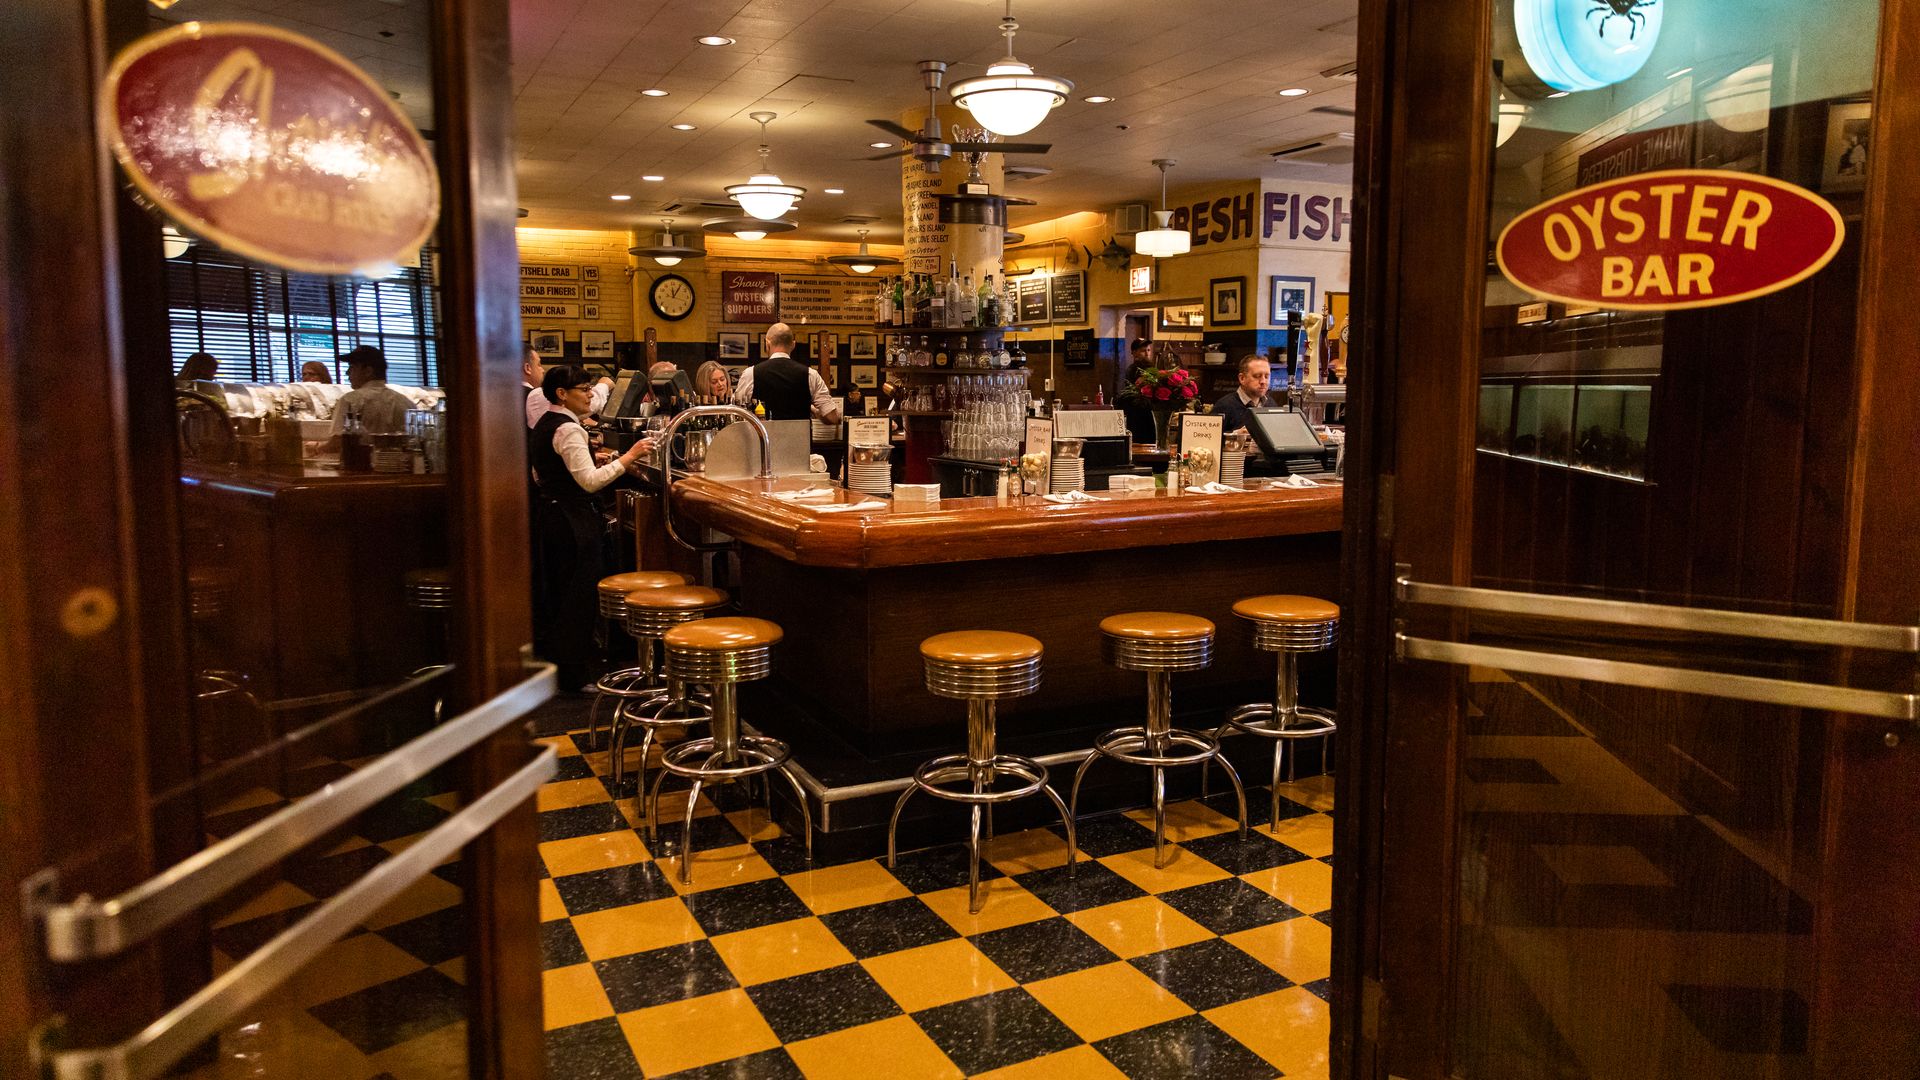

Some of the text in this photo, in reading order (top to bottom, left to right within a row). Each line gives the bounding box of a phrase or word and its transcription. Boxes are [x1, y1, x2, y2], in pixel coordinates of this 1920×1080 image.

[922, 179, 942, 188] ISLAND
[1543, 183, 1774, 262] OYSTER
[927, 224, 946, 233] ISLAND
[931, 234, 949, 243] SELECT
[551, 267, 570, 277] CRAB
[585, 269, 598, 278] YES
[1601, 253, 1715, 297] BAR
[1131, 268, 1148, 287] EXIT
[525, 286, 545, 295] CRAB
[547, 286, 576, 296] FINGERS
[586, 288, 596, 297] NO
[734, 292, 765, 302] OYSTER
[520, 305, 566, 315] SNOW CRAB
[587, 307, 597, 316] NO
[727, 304, 772, 314] SUPPLIERS
[1185, 420, 1208, 430] OYSTER
